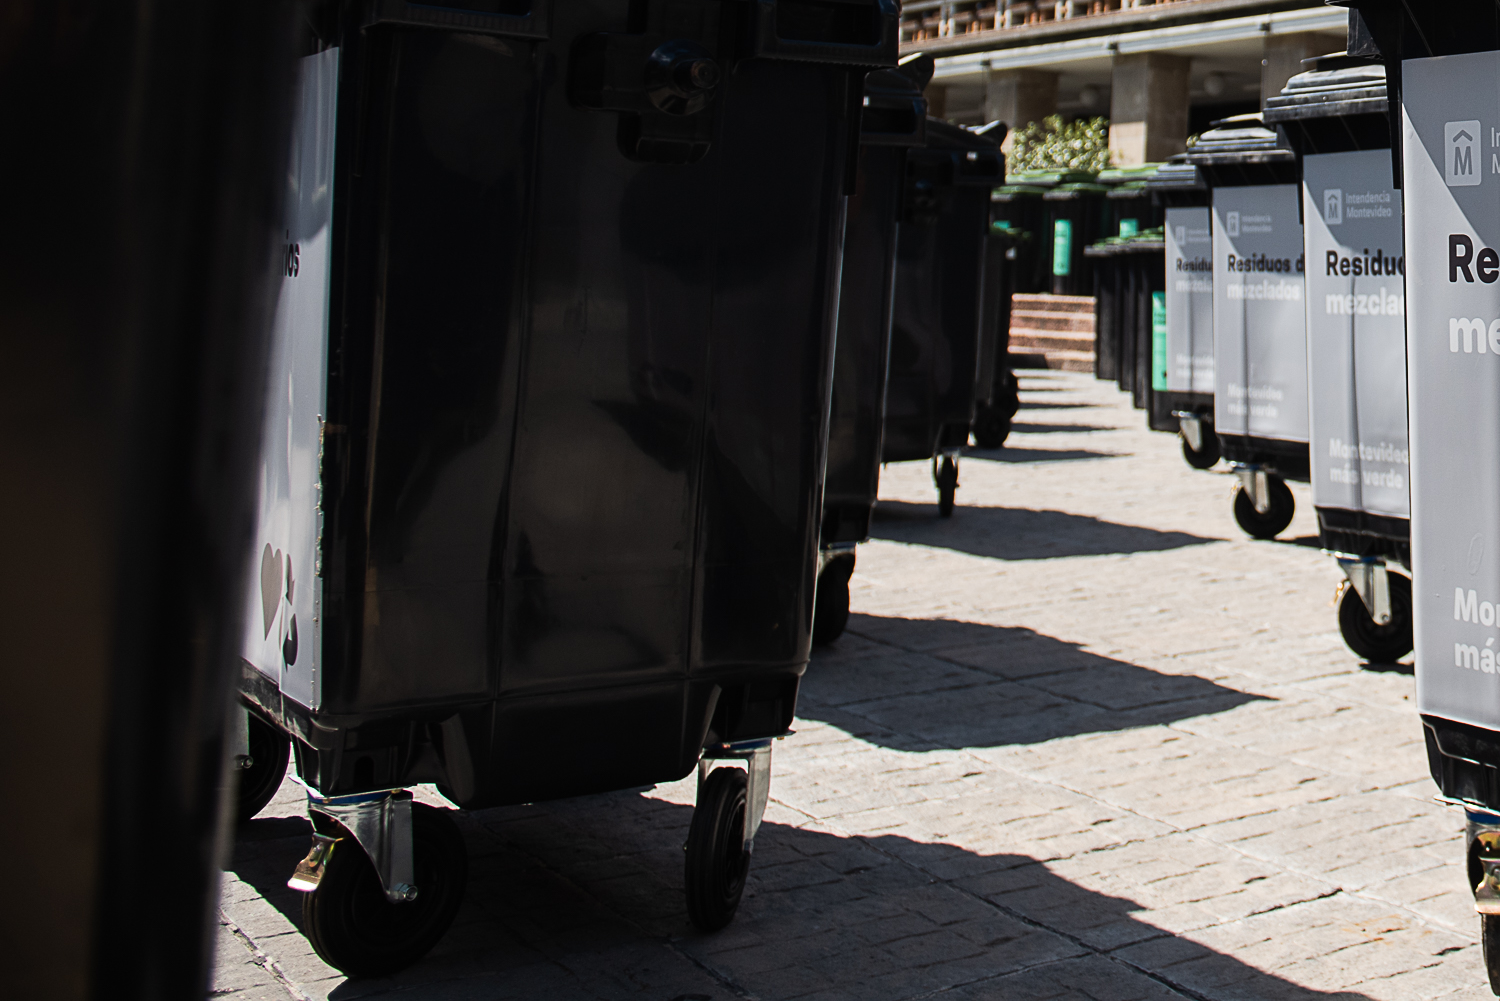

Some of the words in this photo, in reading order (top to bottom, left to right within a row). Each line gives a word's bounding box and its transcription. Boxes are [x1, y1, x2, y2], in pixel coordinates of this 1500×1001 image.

[1346, 191, 1391, 205] Intendencia
[1346, 206, 1393, 219] Montevideo
[1228, 252, 1291, 273] Residuos
[1227, 279, 1300, 300] mezclados
[1362, 469, 1404, 490] verde
